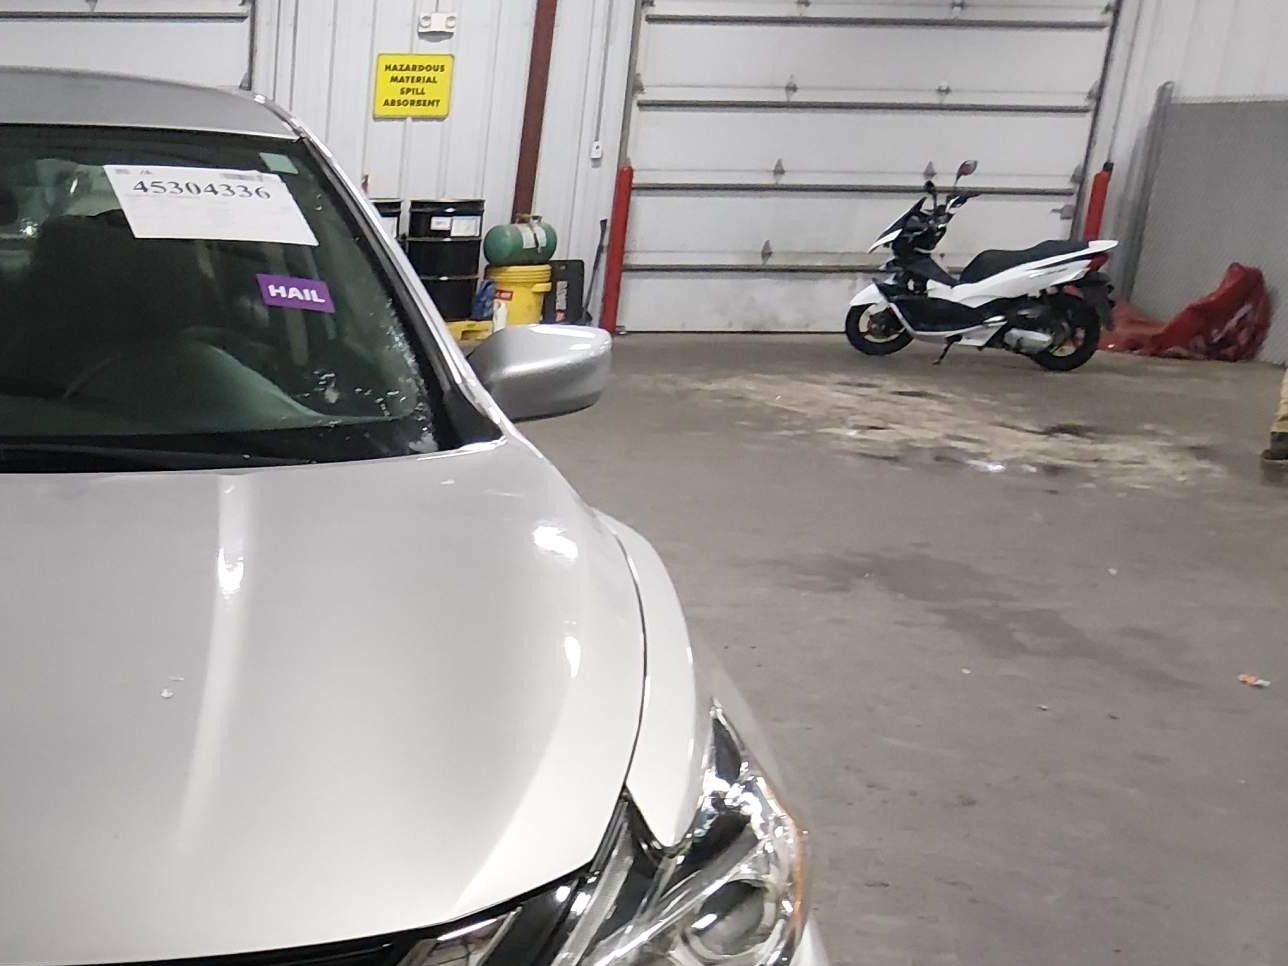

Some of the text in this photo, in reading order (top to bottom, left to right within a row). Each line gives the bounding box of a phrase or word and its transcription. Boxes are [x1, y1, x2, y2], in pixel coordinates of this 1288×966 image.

[384, 64, 445, 72] HAZARDOUS
[390, 76, 437, 84] MATERIAL
[400, 87, 425, 95] SPILL
[383, 99, 440, 107] ABSORBENT
[133, 180, 271, 200] 45304336
[268, 284, 325, 303] HAIL
